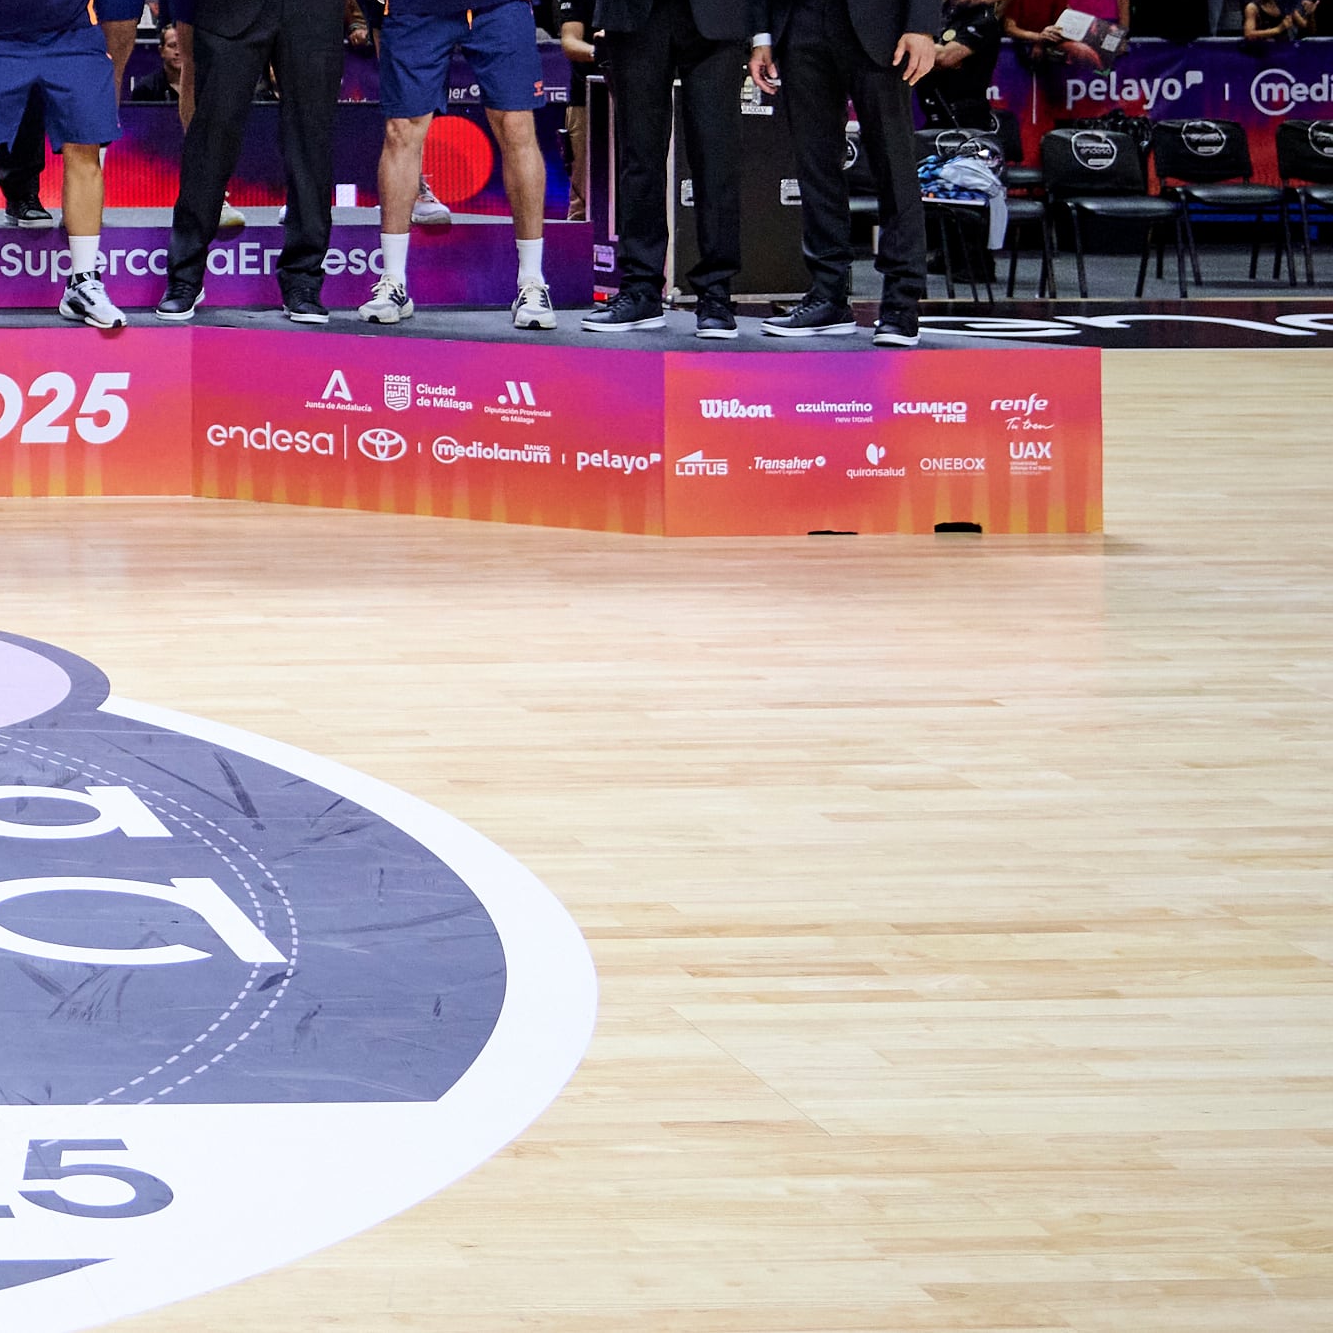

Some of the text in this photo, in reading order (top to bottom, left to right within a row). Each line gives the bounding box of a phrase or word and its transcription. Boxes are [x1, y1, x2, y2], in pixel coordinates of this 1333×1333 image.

[1066, 71, 1182, 110] pelayo
[416, 384, 455, 396] Ciudad
[417, 397, 472, 411] de Málaga
[700, 399, 772, 418] Wilson
[796, 401, 872, 412] azulmarino
[894, 402, 966, 413] KUMHO
[991, 393, 1048, 416] renfe
[933, 414, 965, 422] TIRE
[207, 422, 333, 455] endesa
[437, 439, 550, 463] mediolanum
[1010, 442, 1051, 458] UAX
[577, 450, 648, 474] pelayo
[676, 463, 727, 475] LOTUS
[920, 458, 984, 470] ONEBOX
